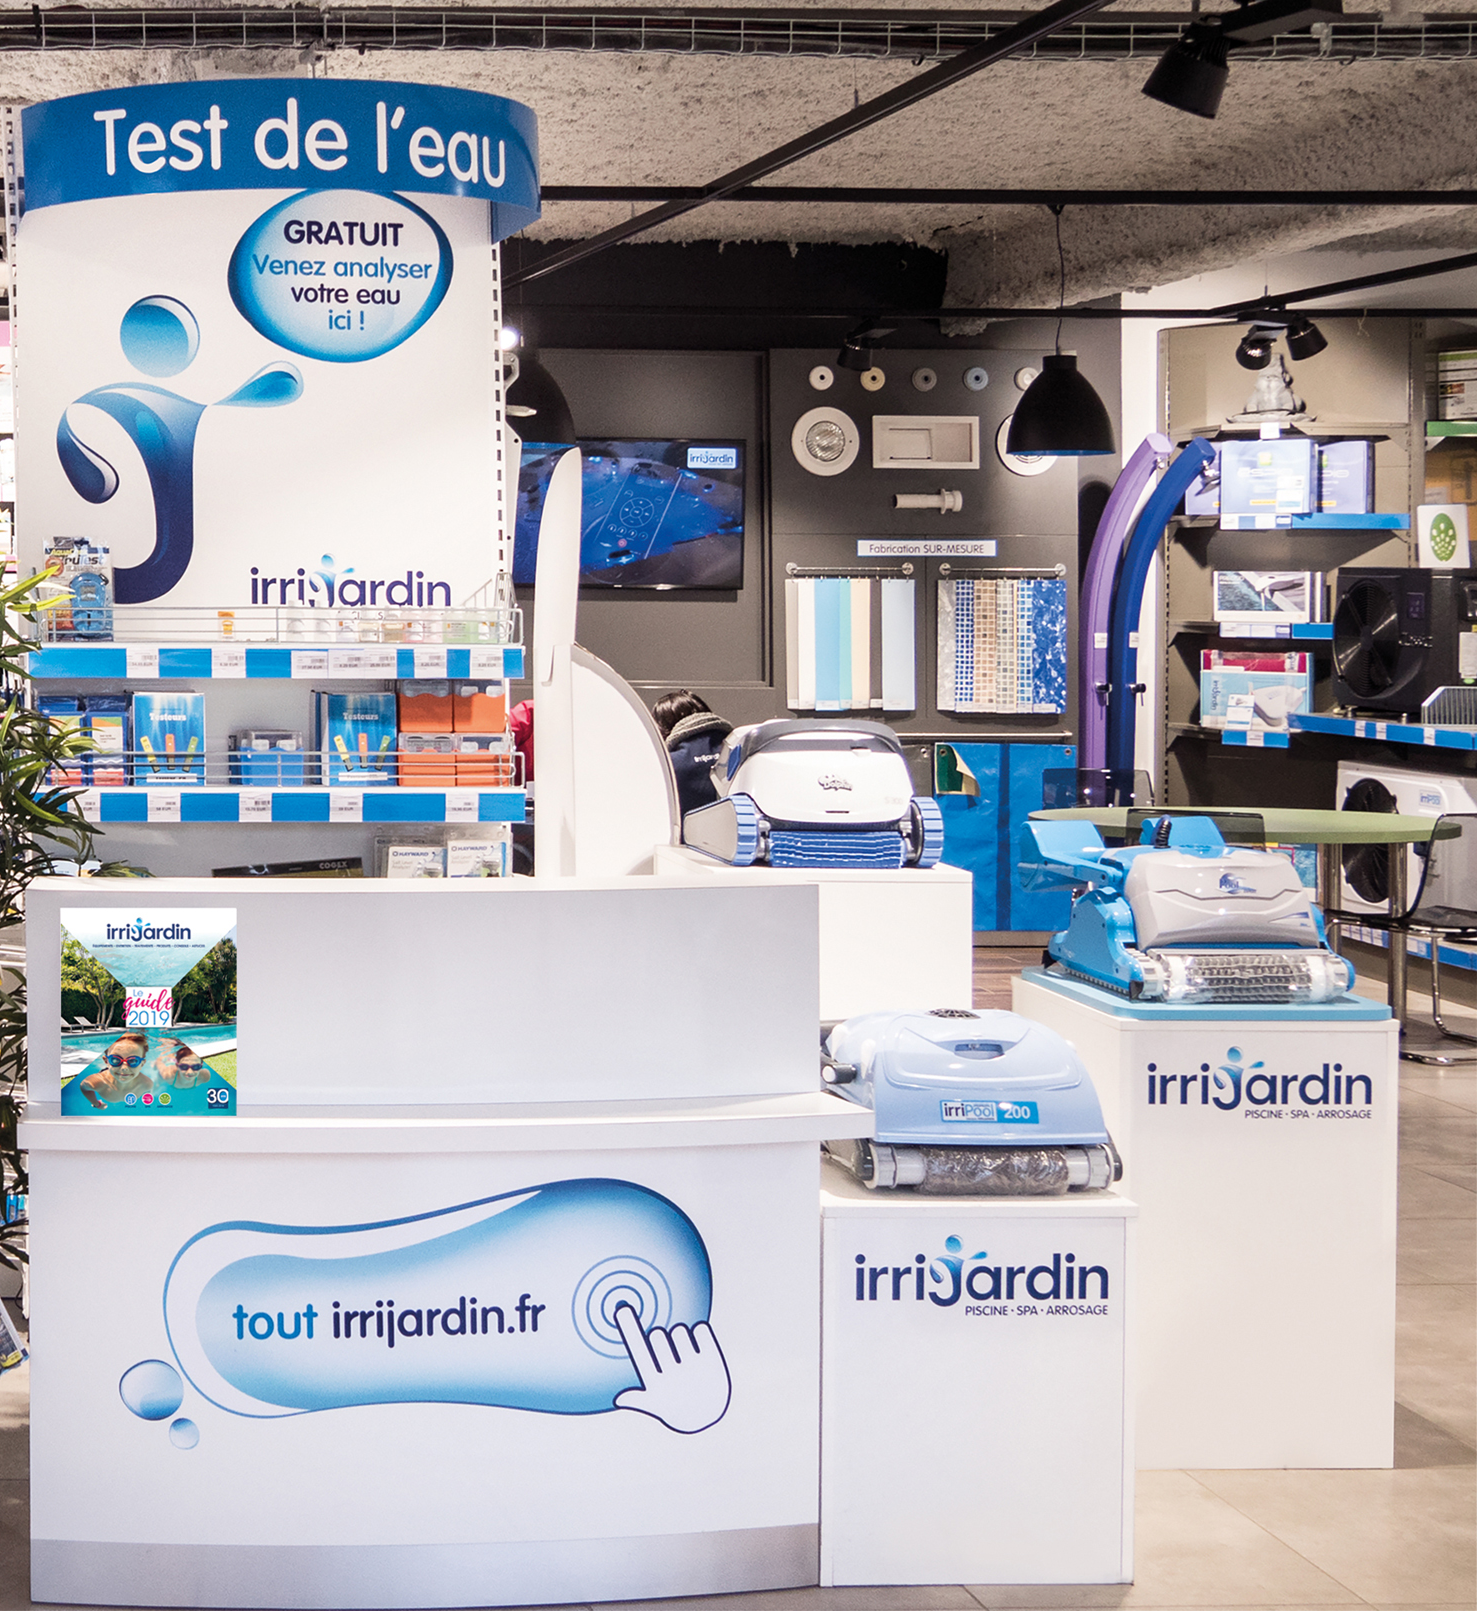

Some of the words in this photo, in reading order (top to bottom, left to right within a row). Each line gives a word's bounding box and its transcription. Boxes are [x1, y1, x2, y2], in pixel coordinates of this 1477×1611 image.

[93, 104, 229, 176] Test
[254, 97, 349, 171] de
[376, 101, 506, 188] l'eau
[283, 219, 404, 247] GRATUIT
[252, 254, 325, 276] Venez
[333, 256, 433, 284] analyser
[290, 285, 348, 305] votre
[356, 288, 401, 306] eau
[328, 310, 353, 331] ici
[360, 311, 365, 331] !
[690, 451, 734, 463] irrijardin
[869, 543, 921, 554] Fabrication
[923, 544, 985, 554] SUR-MESURE
[251, 556, 452, 608] irrijardin
[149, 712, 187, 722] Testeurs
[343, 712, 379, 721] Testeurs
[106, 917, 192, 942] irrijardin
[132, 989, 144, 998] Le
[121, 989, 176, 1021] guide
[128, 1010, 171, 1026] 2019
[1147, 1046, 1373, 1111] irrijardin
[207, 1088, 229, 1104] 30
[944, 1103, 995, 1118] irriPool
[1004, 1106, 1031, 1119] 200
[1244, 1110, 1283, 1119] PISCINE
[1290, 1110, 1310, 1119] SPA
[1316, 1110, 1372, 1119] ARROSAGE
[855, 1234, 1109, 1307] irrijardin
[964, 1305, 1008, 1316] PISCINE
[1016, 1305, 1039, 1316] SPA
[1045, 1304, 1109, 1316] ARROSAGE
[233, 1304, 318, 1341] tout
[332, 1293, 546, 1349] irrijardin.fr
